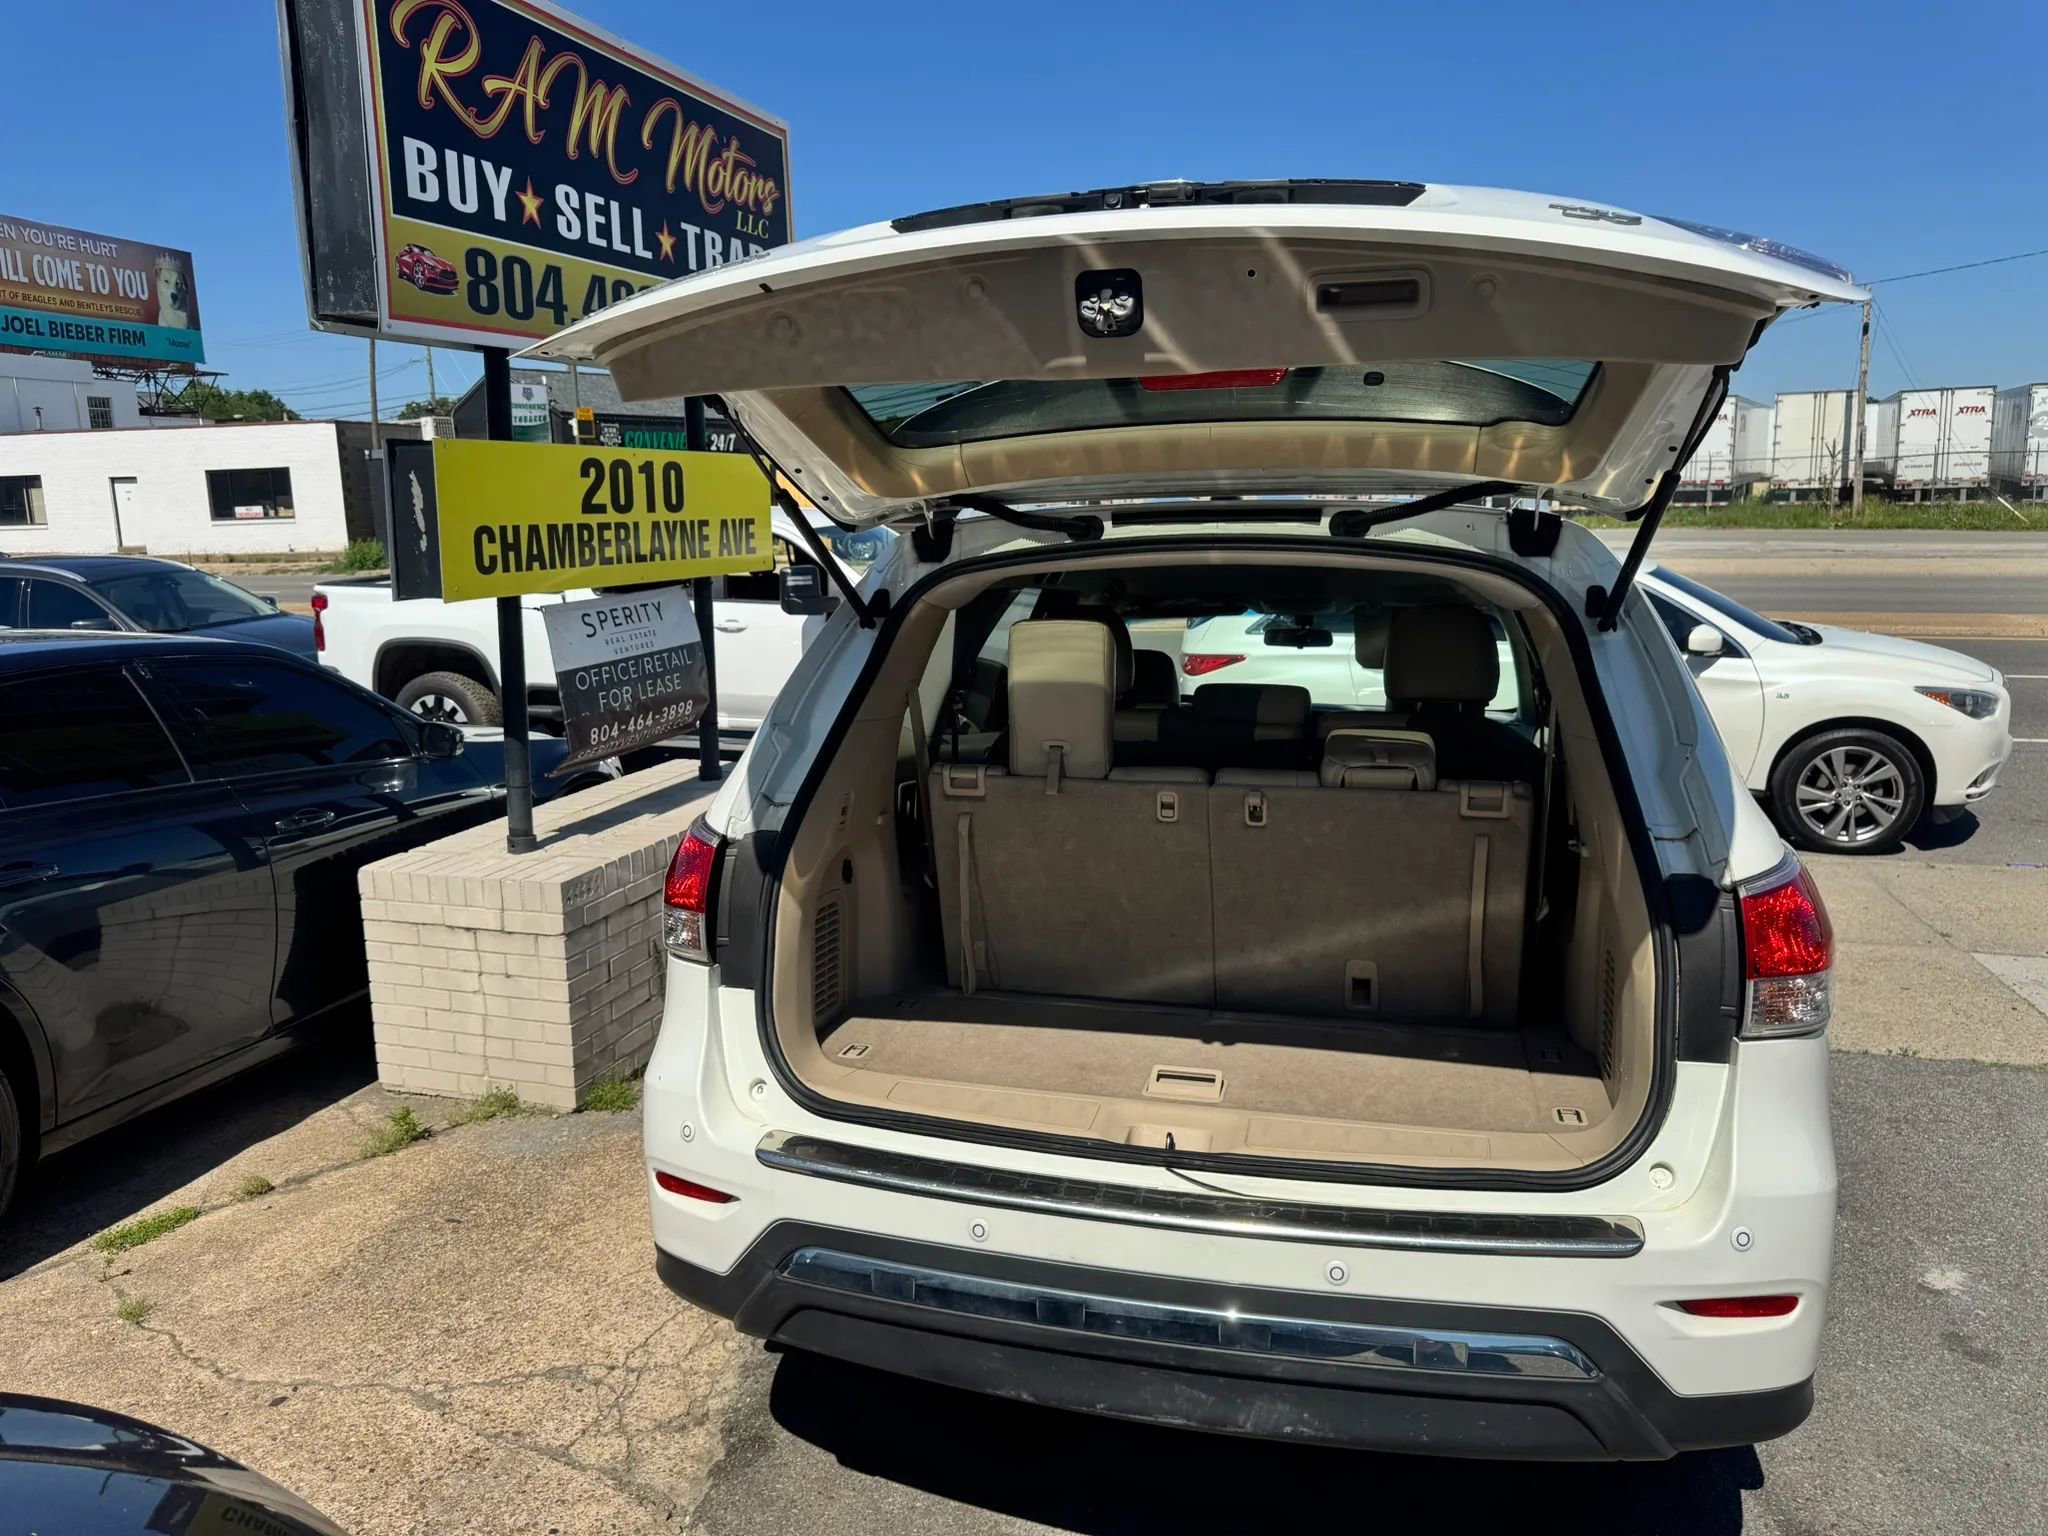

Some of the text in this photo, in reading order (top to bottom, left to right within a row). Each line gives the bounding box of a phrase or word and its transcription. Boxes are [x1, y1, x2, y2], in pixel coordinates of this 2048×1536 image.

[390, 0, 780, 215] RAM Motors
[402, 136, 512, 222] BUY
[556, 184, 653, 260] SELL
[19, 226, 77, 251] YOU'RE
[79, 237, 118, 258] HURT
[736, 210, 769, 239] LLC
[32, 254, 84, 292] COME
[85, 262, 110, 295] TO
[112, 267, 149, 300] YOU
[465, 247, 651, 326] 804.4
[9, 290, 21, 300] OF
[22, 293, 57, 305] BEAGLES
[60, 299, 75, 308] AND
[77, 301, 113, 313] BENTLEYS
[115, 305, 142, 316] RESCUE
[1, 314, 45, 336] JOEL
[48, 320, 105, 343] BIEBER
[109, 328, 147, 347] FIRM
[1907, 408, 1937, 419] XTRA
[1955, 406, 1986, 416] XTRA
[710, 433, 736, 452] 24/7
[580, 457, 685, 515] 2010
[473, 518, 757, 576] CHAMBERLAYNE AVE
[581, 600, 664, 638] SPERITY
[604, 629, 657, 646] REAL ESTATE
[614, 640, 655, 655] VENTURES
[575, 648, 692, 691] OFFICE/RETAIL
[599, 673, 682, 713] FOR LEASE
[590, 699, 694, 746] 804-464-3898
